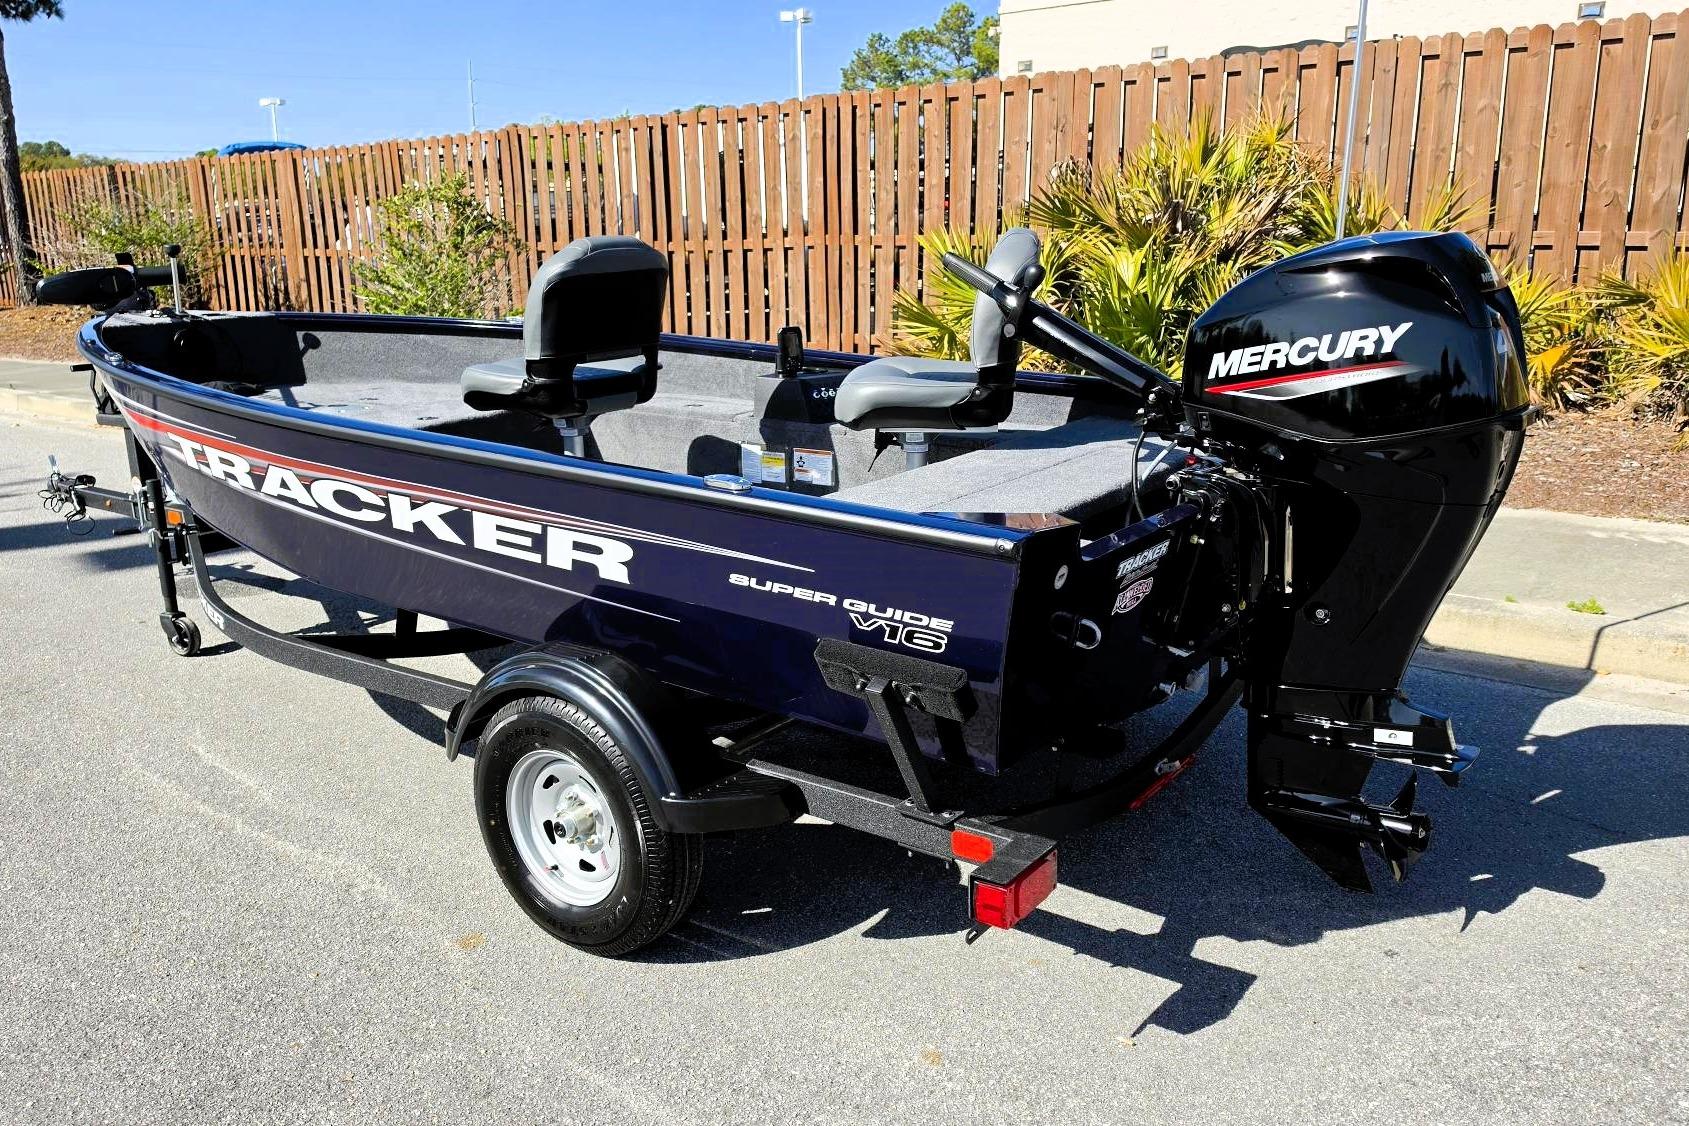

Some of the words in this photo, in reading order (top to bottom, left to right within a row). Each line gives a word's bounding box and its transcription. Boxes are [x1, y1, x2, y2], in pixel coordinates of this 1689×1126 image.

[1207, 321, 1413, 380] MERCURY
[166, 430, 635, 585] TRACKER
[1116, 539, 1171, 579] TRACKER
[728, 573, 837, 606] SUPER
[843, 598, 954, 632] GUIDE
[849, 612, 948, 653] V16
